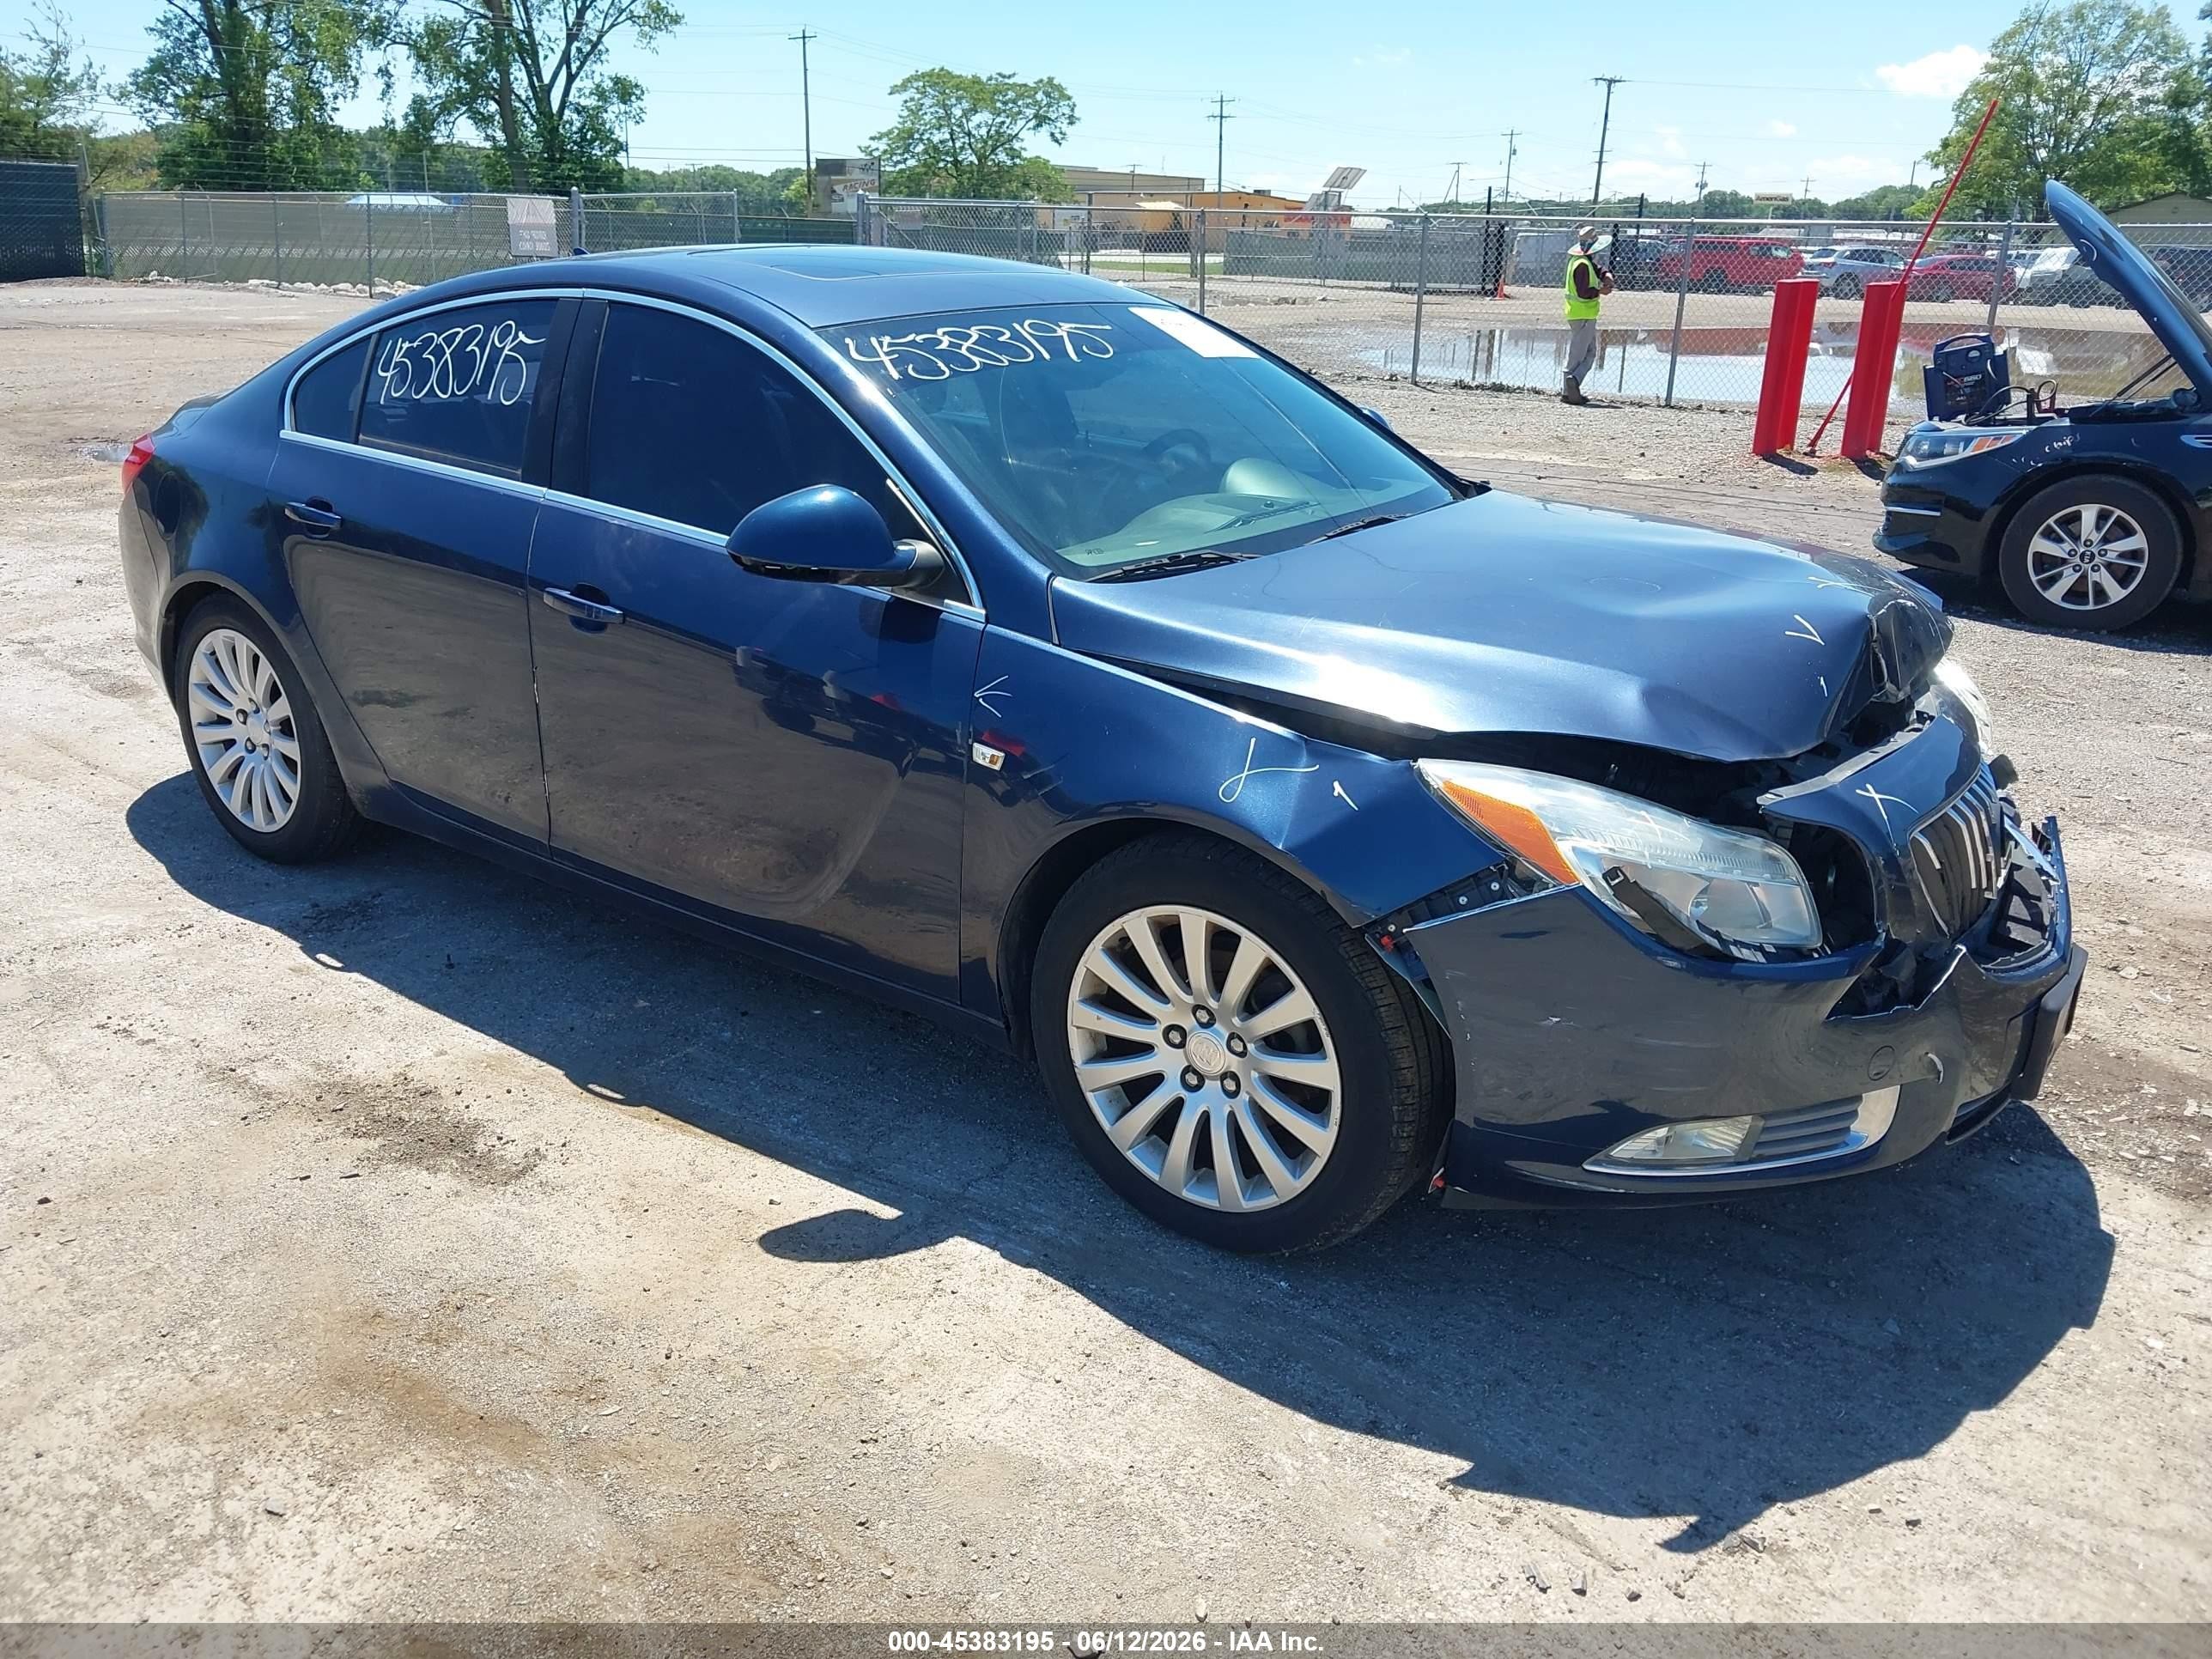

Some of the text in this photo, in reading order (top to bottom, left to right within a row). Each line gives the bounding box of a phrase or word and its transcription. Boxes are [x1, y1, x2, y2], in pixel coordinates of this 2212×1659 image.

[842, 179, 876, 191] RACING
[377, 320, 546, 405] 45383195
[845, 319, 1115, 381] 45383195
